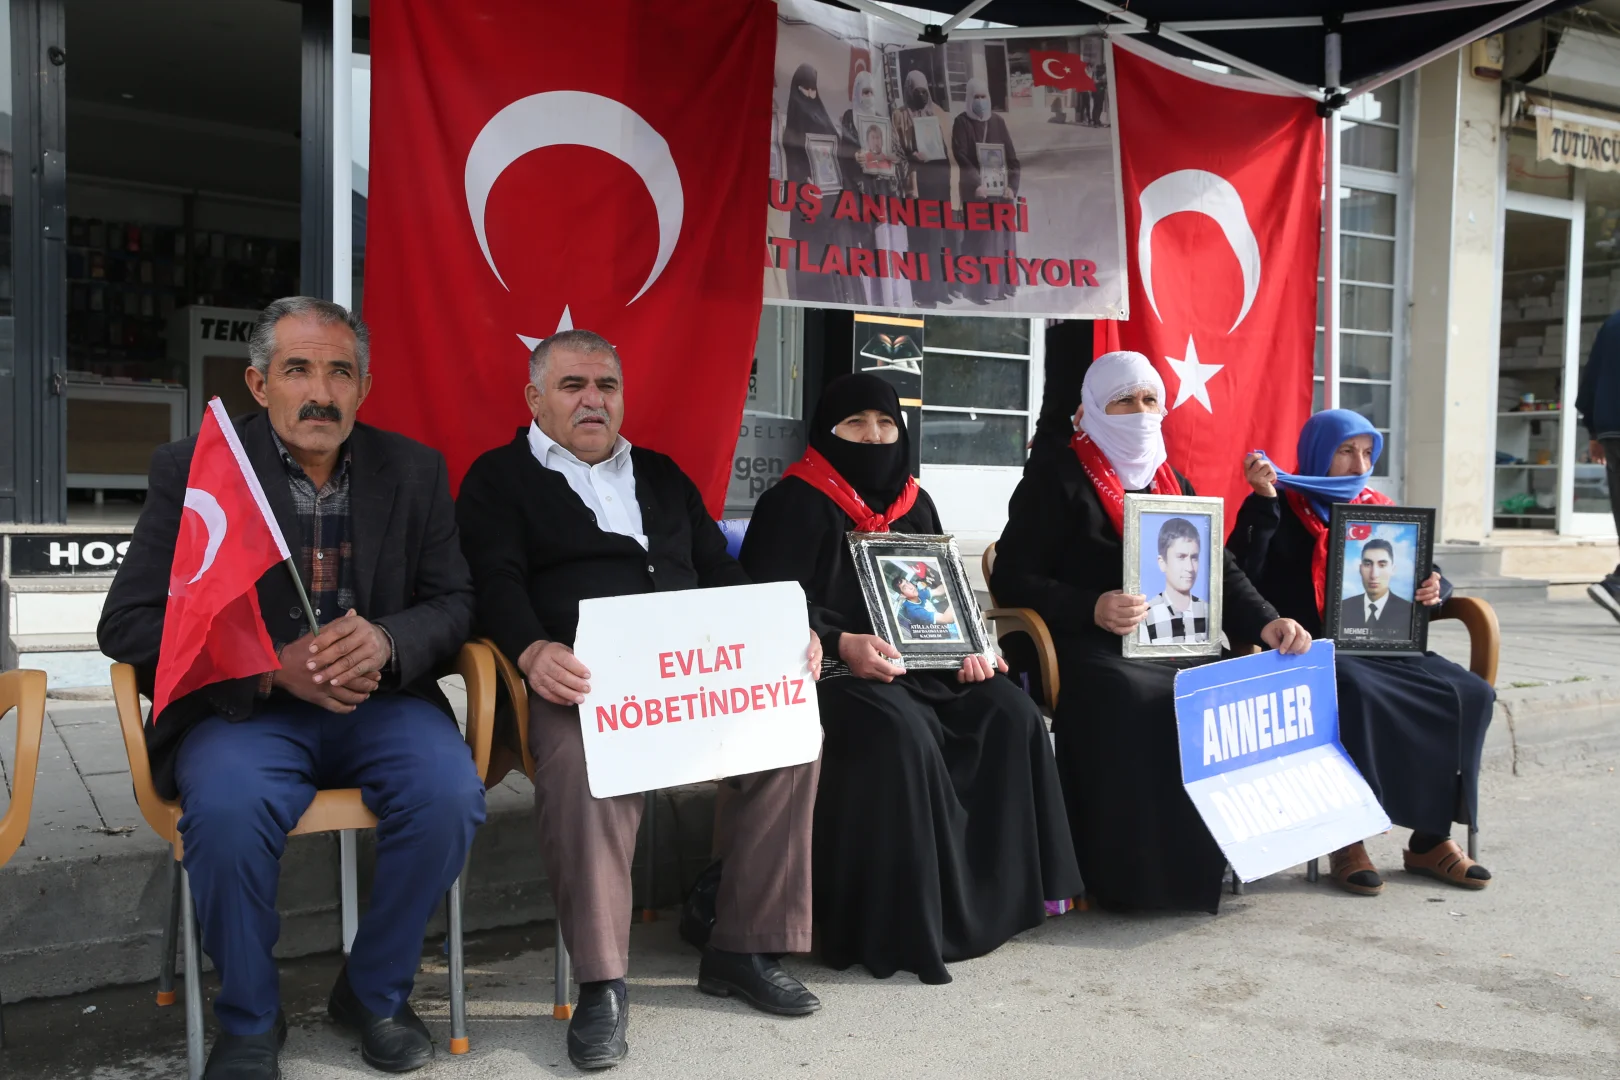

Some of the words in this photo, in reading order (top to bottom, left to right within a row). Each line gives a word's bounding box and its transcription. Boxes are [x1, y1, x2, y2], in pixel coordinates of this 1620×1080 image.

[831, 190, 1029, 233] ANNELERİ
[943, 248, 1100, 287] İSTİYOR
[740, 425, 799, 438] DELTA
[735, 456, 783, 480] gen
[659, 643, 745, 678] EVLAT
[596, 675, 806, 732] NÖBETİNDEYİZ
[1203, 684, 1314, 766] ANNELER
